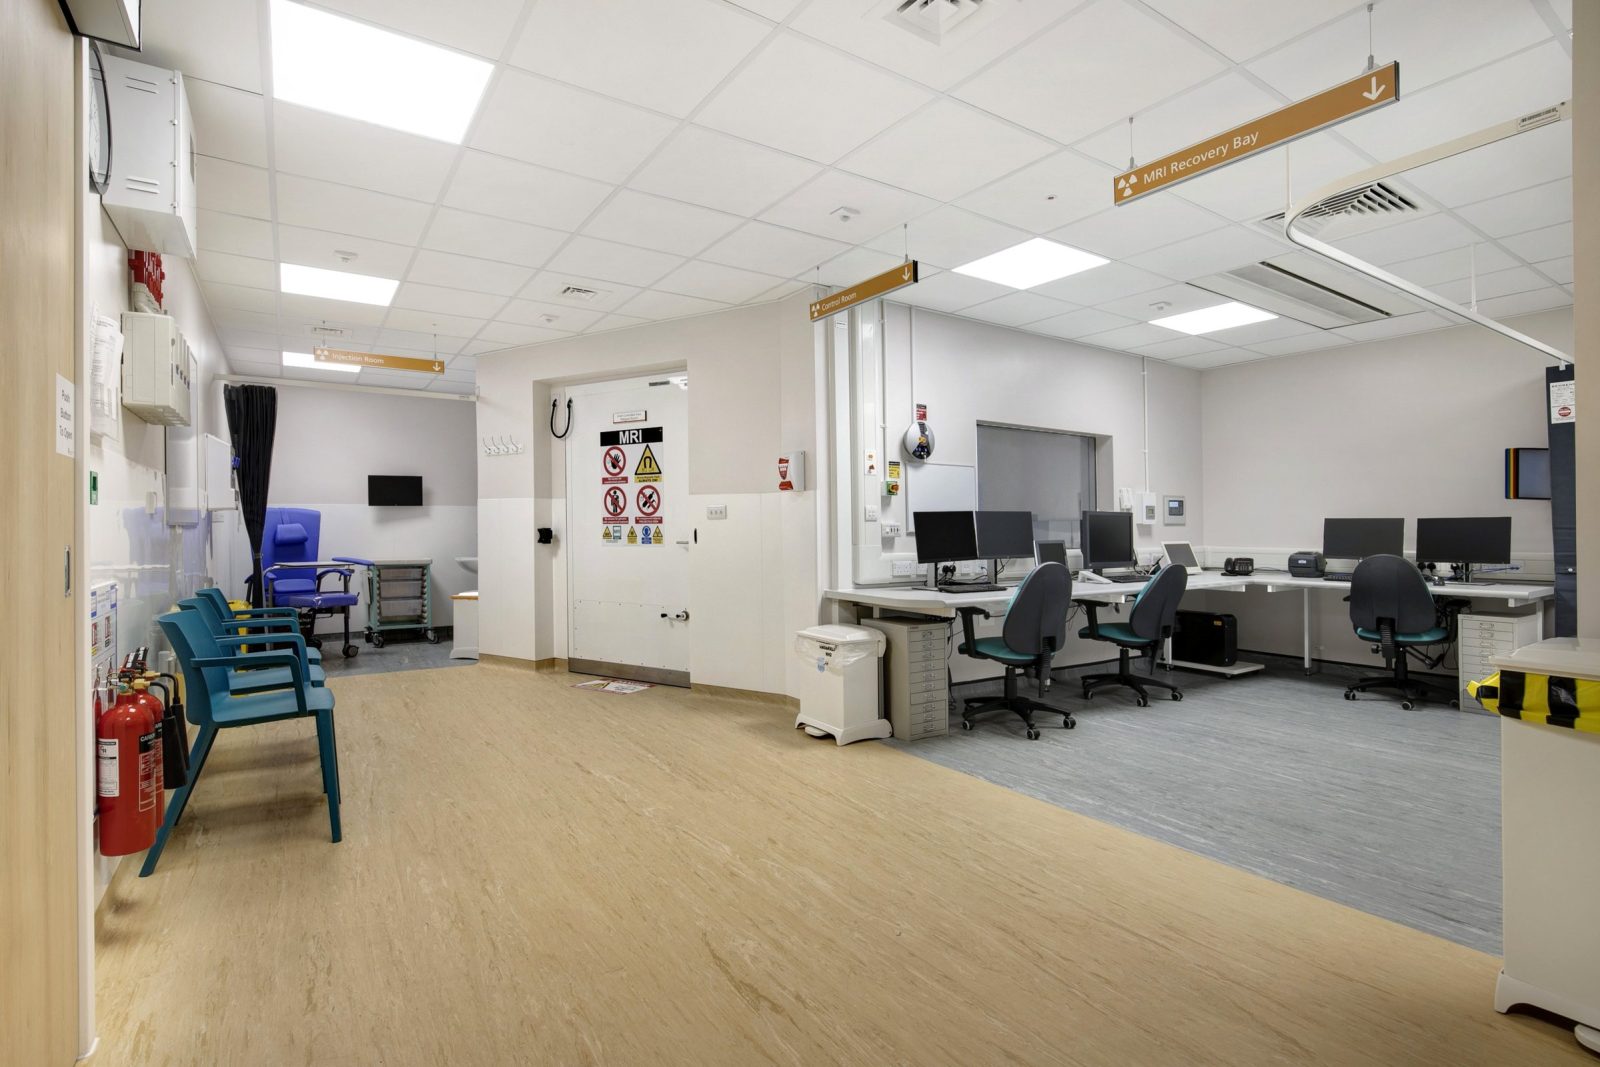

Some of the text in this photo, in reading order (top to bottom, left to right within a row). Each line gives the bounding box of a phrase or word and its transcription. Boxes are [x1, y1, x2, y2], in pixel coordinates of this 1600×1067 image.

[1143, 131, 1259, 185] MRI Recovery Bay
[821, 292, 857, 311] Control Room
[332, 352, 385, 364] Injection Room
[619, 429, 643, 445] MRI
